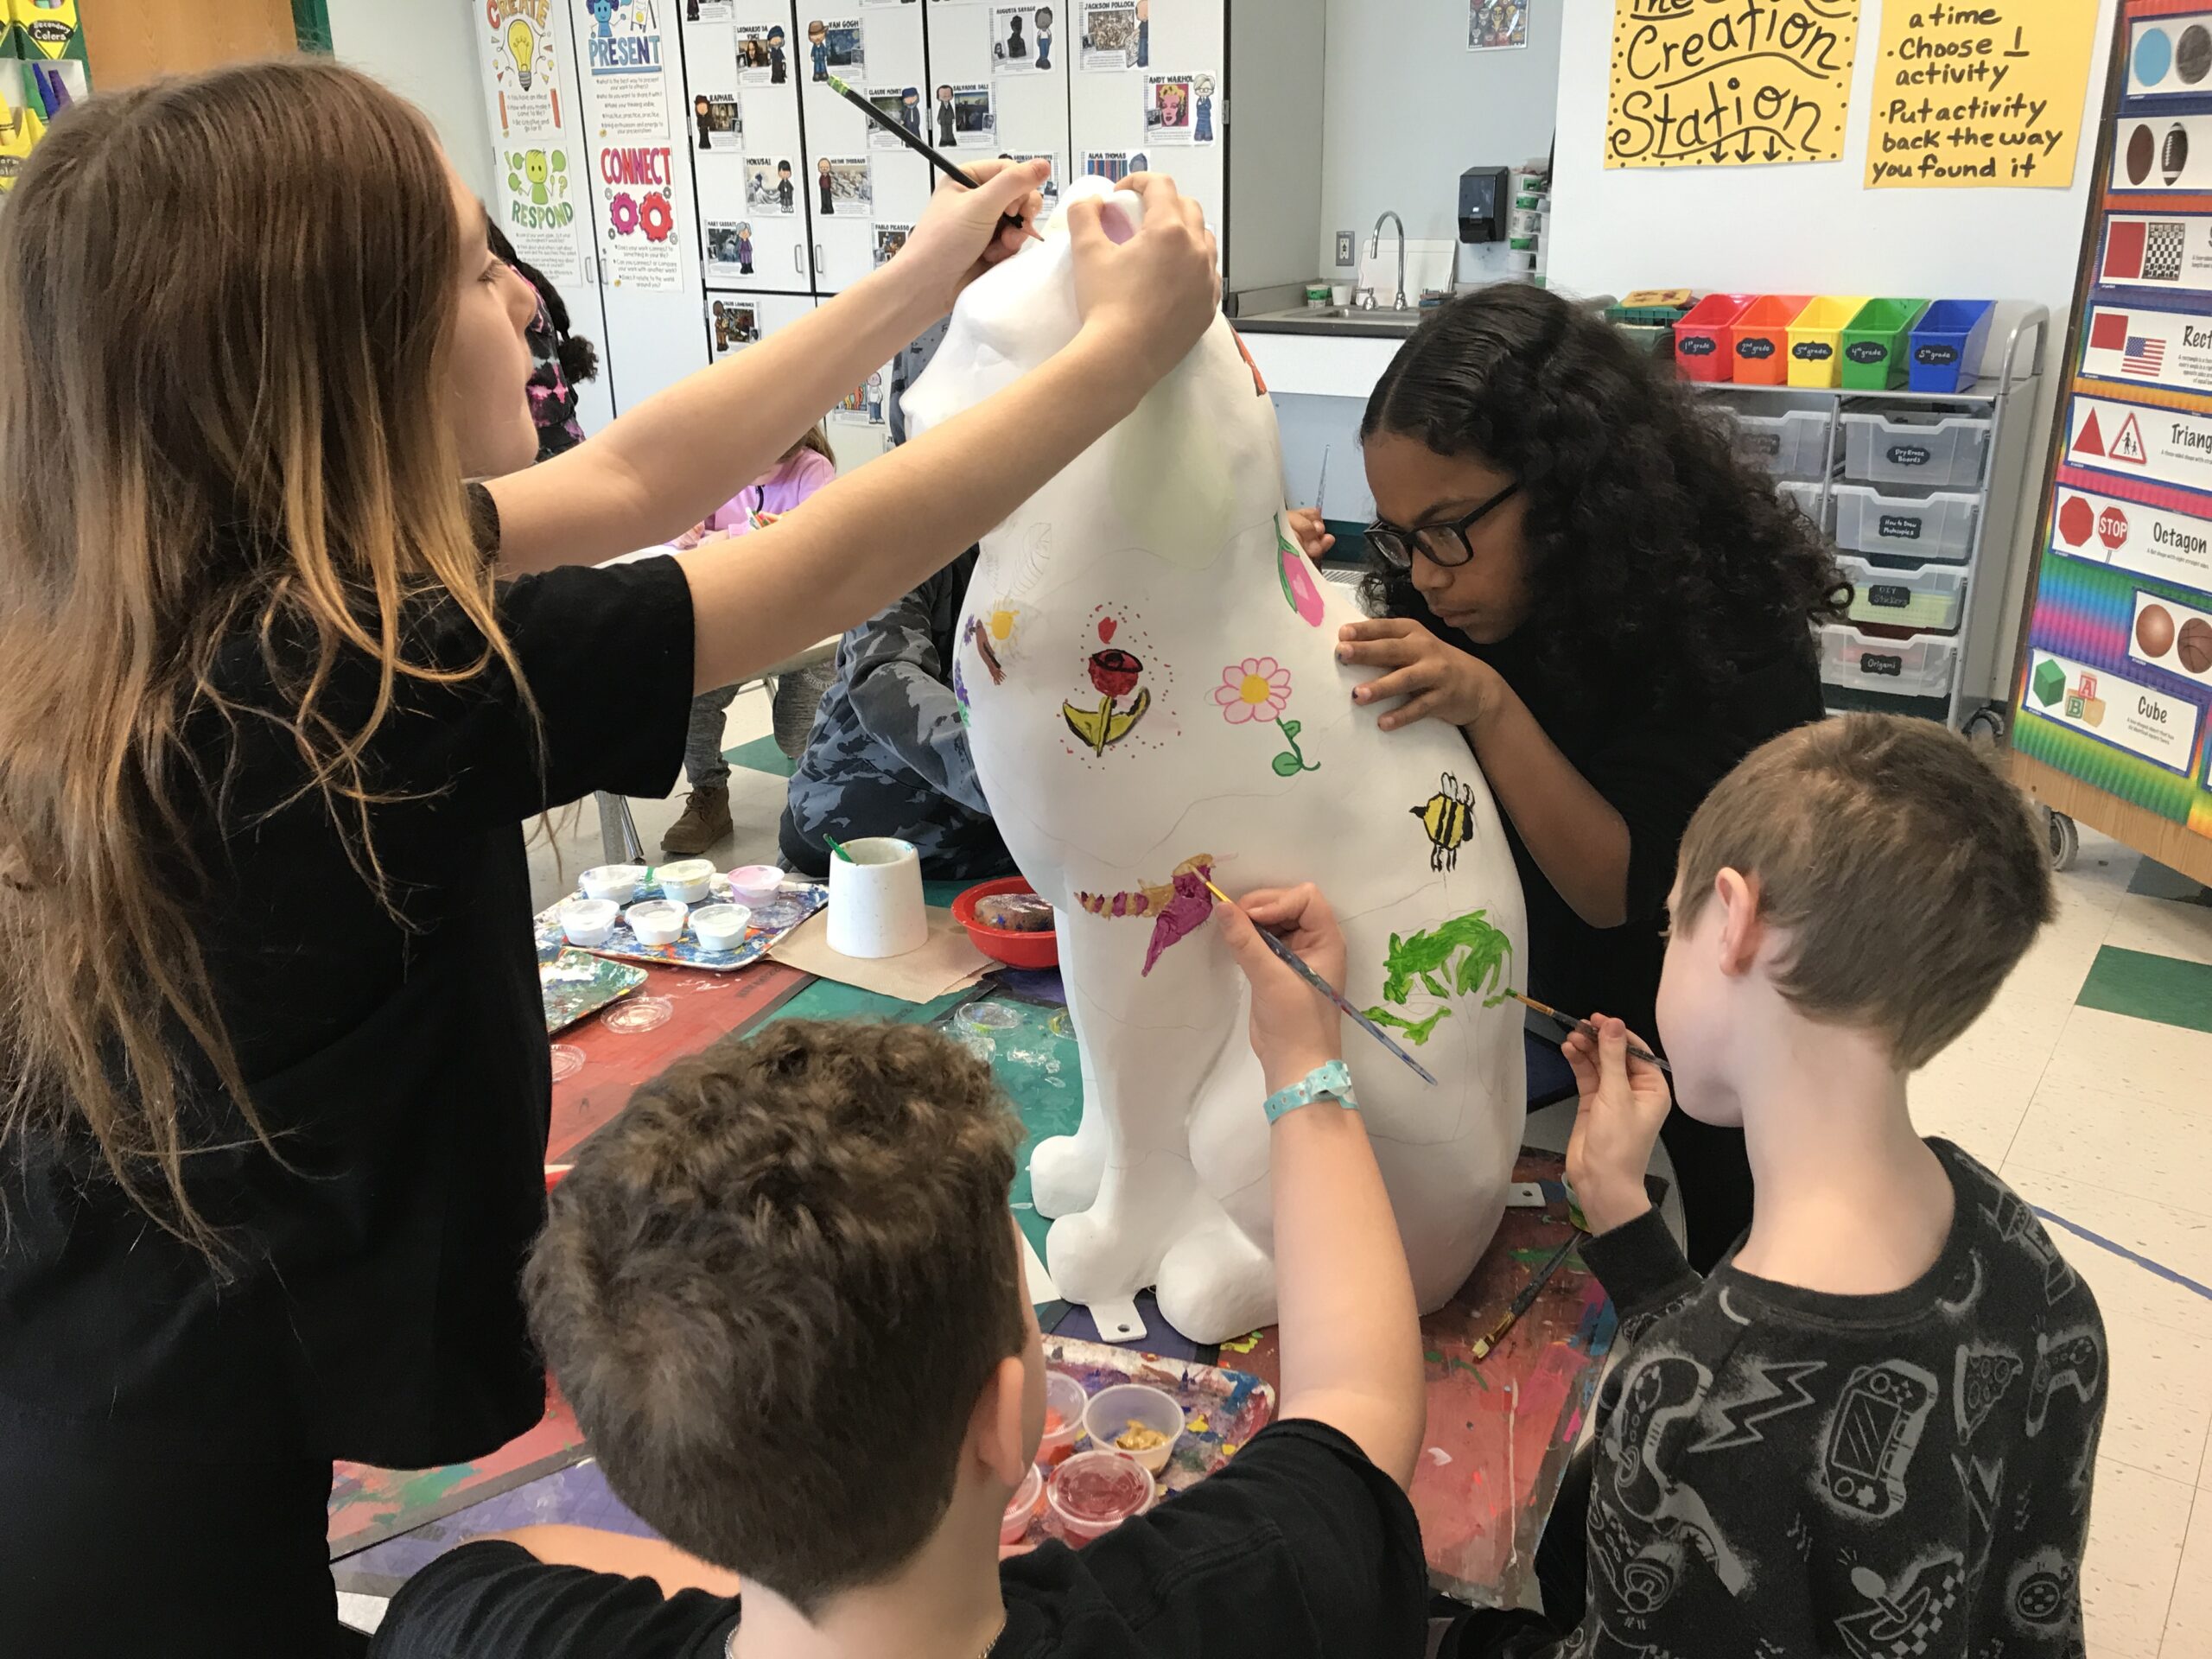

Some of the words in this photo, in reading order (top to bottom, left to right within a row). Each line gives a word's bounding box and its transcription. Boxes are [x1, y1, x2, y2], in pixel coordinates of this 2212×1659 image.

[486, 0, 550, 29] CREATE
[1909, 14, 1924, 29] a
[1929, 3, 2002, 26] time
[34, 22, 71, 34] Secondary
[35, 29, 67, 40] Colors
[1627, 0, 1840, 79] Creation
[588, 35, 660, 67] PRESENT
[1899, 36, 1993, 60] Choose
[1896, 60, 2009, 92] activity
[1611, 77, 1821, 158] Station
[1889, 98, 1933, 124] Put
[1936, 92, 2047, 128] activity
[1883, 130, 1941, 153] back
[1947, 127, 1994, 148] the
[1999, 130, 2063, 156] way
[601, 148, 671, 185] CONNECT
[1873, 162, 1912, 184] you
[1917, 154, 1996, 179] found
[2012, 153, 2036, 178] it
[512, 200, 573, 230] RESPOND
[1693, 343, 1710, 353] grade
[1741, 343, 1752, 353] 2nd
[1751, 345, 1770, 355] grade
[2183, 325, 2212, 349] Rect
[1796, 346, 1807, 355] 3rd
[1852, 347, 1862, 356] 4th
[1861, 349, 1882, 359] grade
[1918, 349, 1931, 358] 5th
[1930, 351, 1951, 360] grade
[2171, 423, 2212, 454] Triang
[2100, 517, 2127, 538] STOP
[2153, 522, 2207, 553] Octagon
[1874, 594, 1907, 605] Stickers
[1867, 658, 1896, 671] Origami
[2082, 679, 2092, 696] A
[2069, 699, 2082, 715] B
[2139, 696, 2167, 723] Cube
